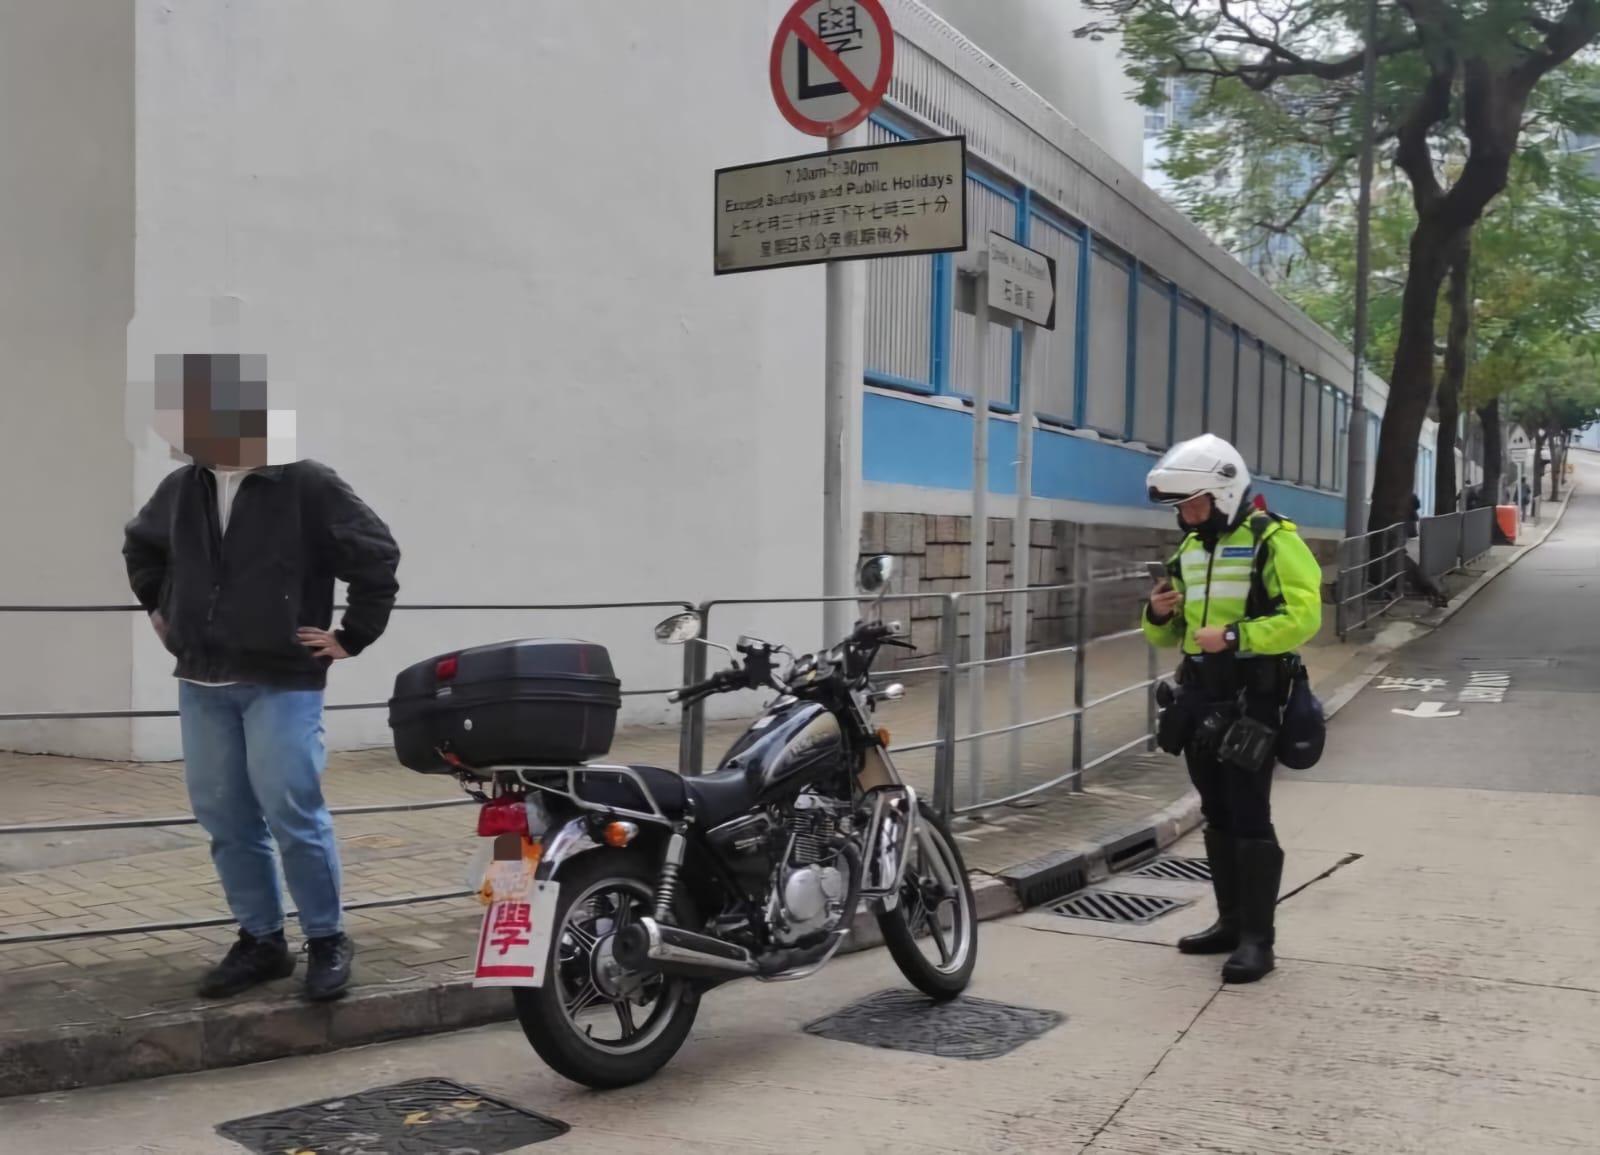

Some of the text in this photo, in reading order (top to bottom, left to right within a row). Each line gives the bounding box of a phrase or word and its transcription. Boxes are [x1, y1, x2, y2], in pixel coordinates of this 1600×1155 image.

[818, 5, 863, 56] 學
[798, 36, 850, 100] L
[766, 191, 816, 206] Sundays
[819, 184, 842, 199] and
[846, 178, 888, 195] Public
[893, 173, 954, 190] Holidays
[490, 902, 532, 956] 學
